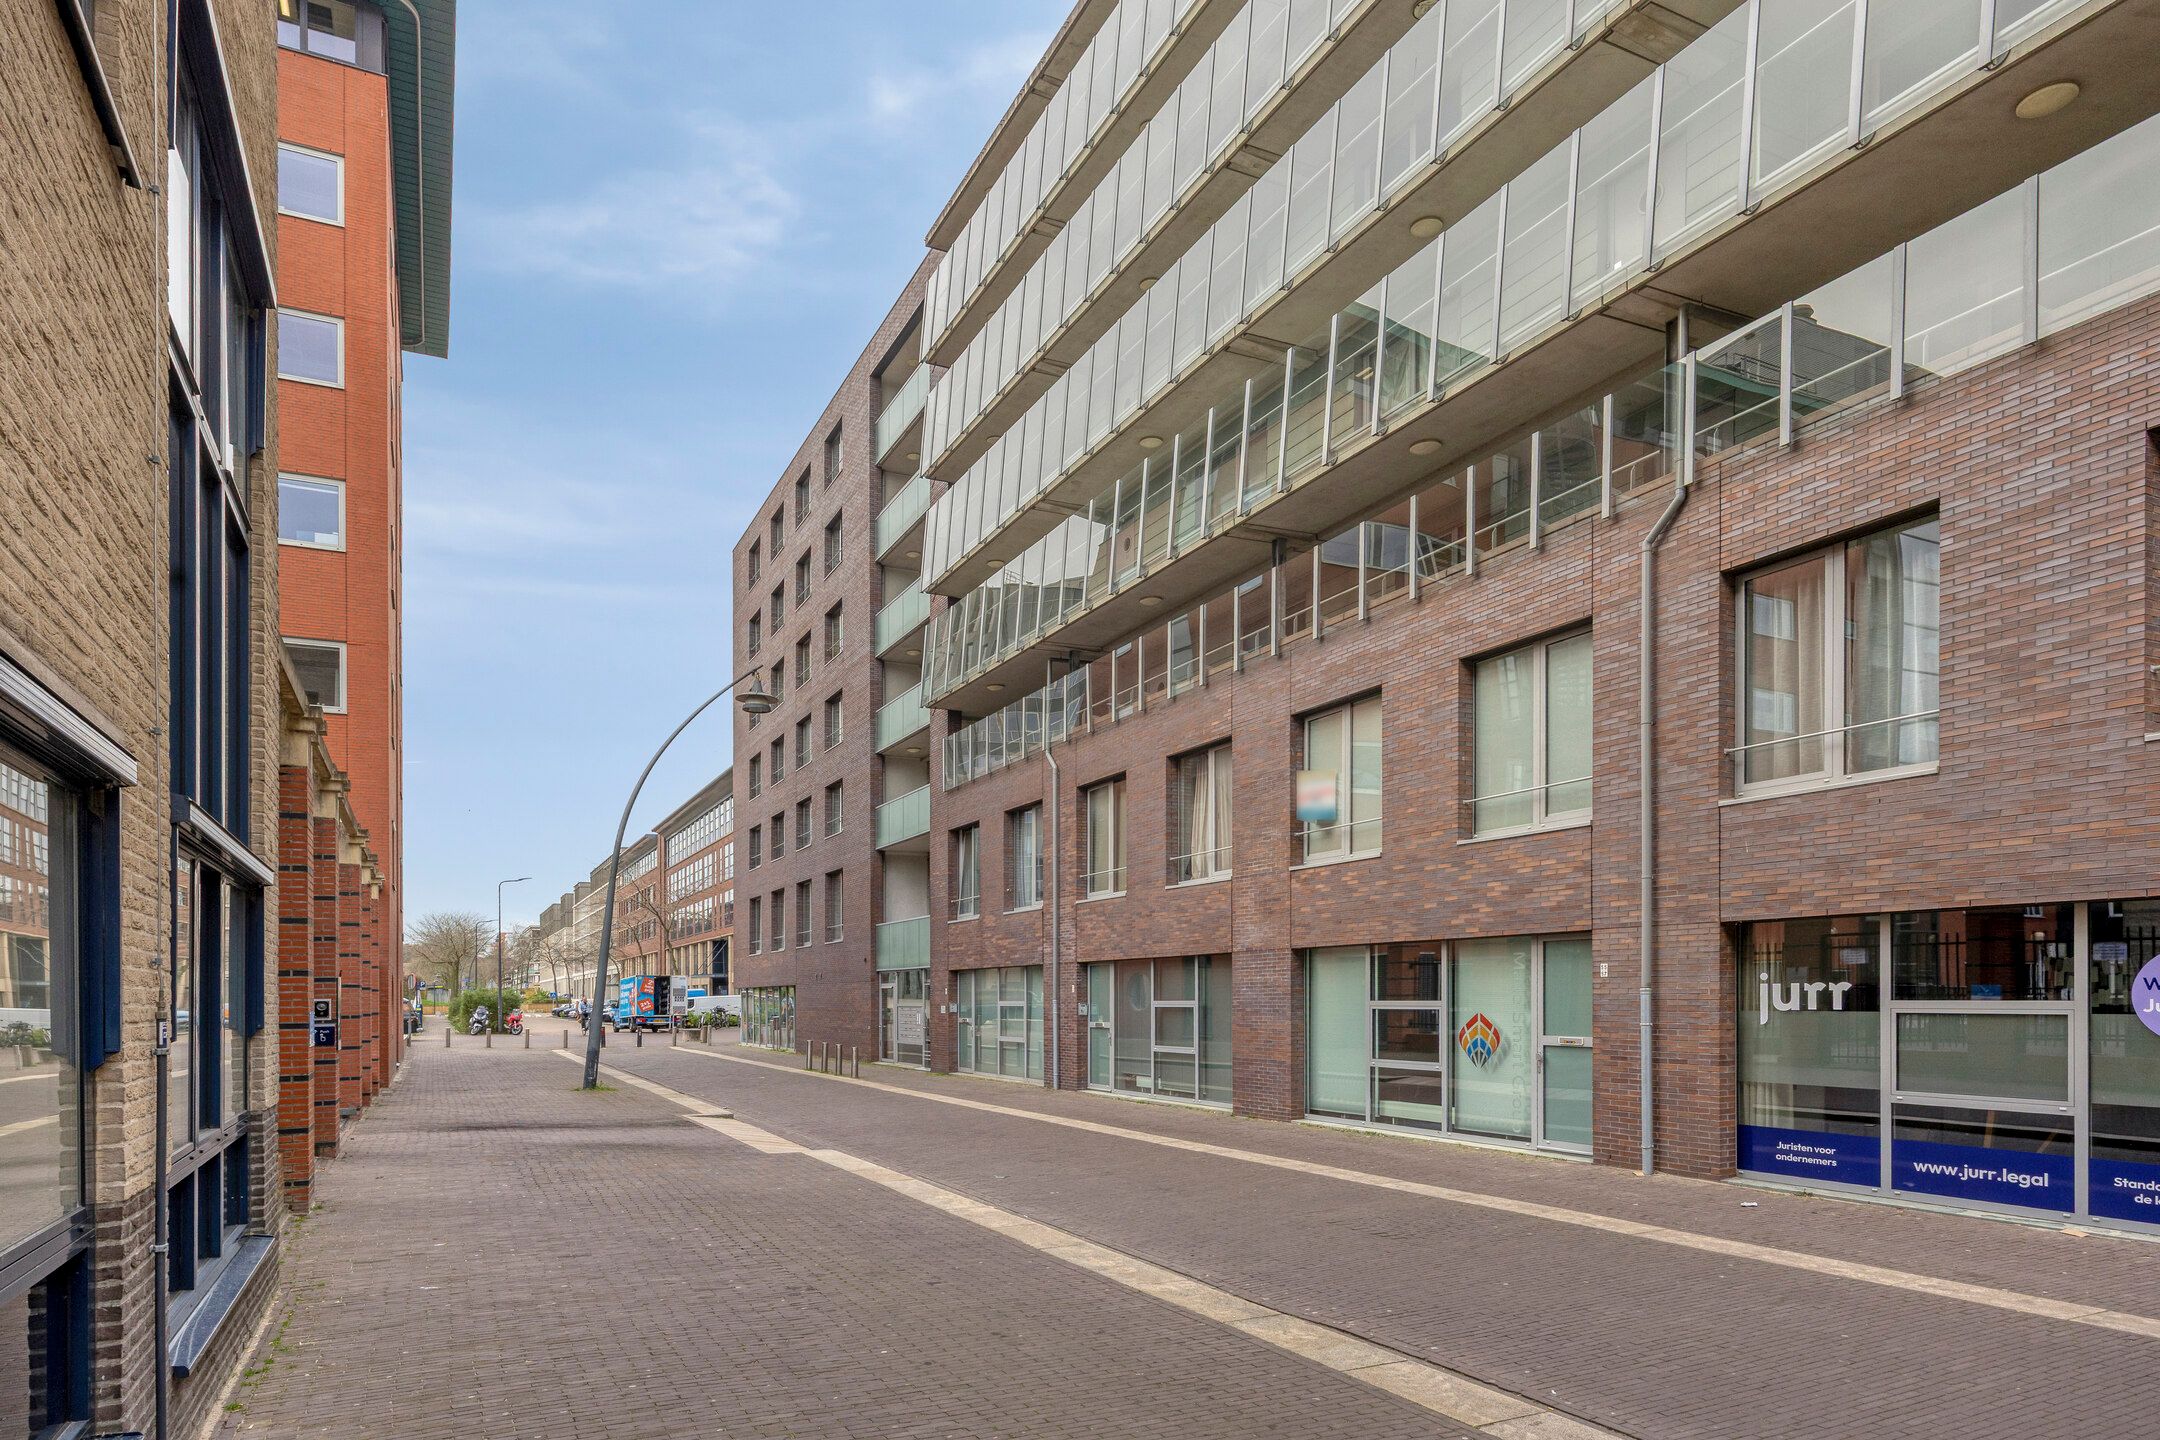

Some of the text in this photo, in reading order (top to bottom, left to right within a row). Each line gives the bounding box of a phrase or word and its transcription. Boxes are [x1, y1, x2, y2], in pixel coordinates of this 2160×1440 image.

[1760, 972, 1852, 1025] jurr
[1776, 1141, 1836, 1155] Juristen voor
[1775, 1153, 1837, 1167] ondernemers
[1913, 1161, 2049, 1188] www.jurr.legal
[2134, 1194, 2152, 1205] de
